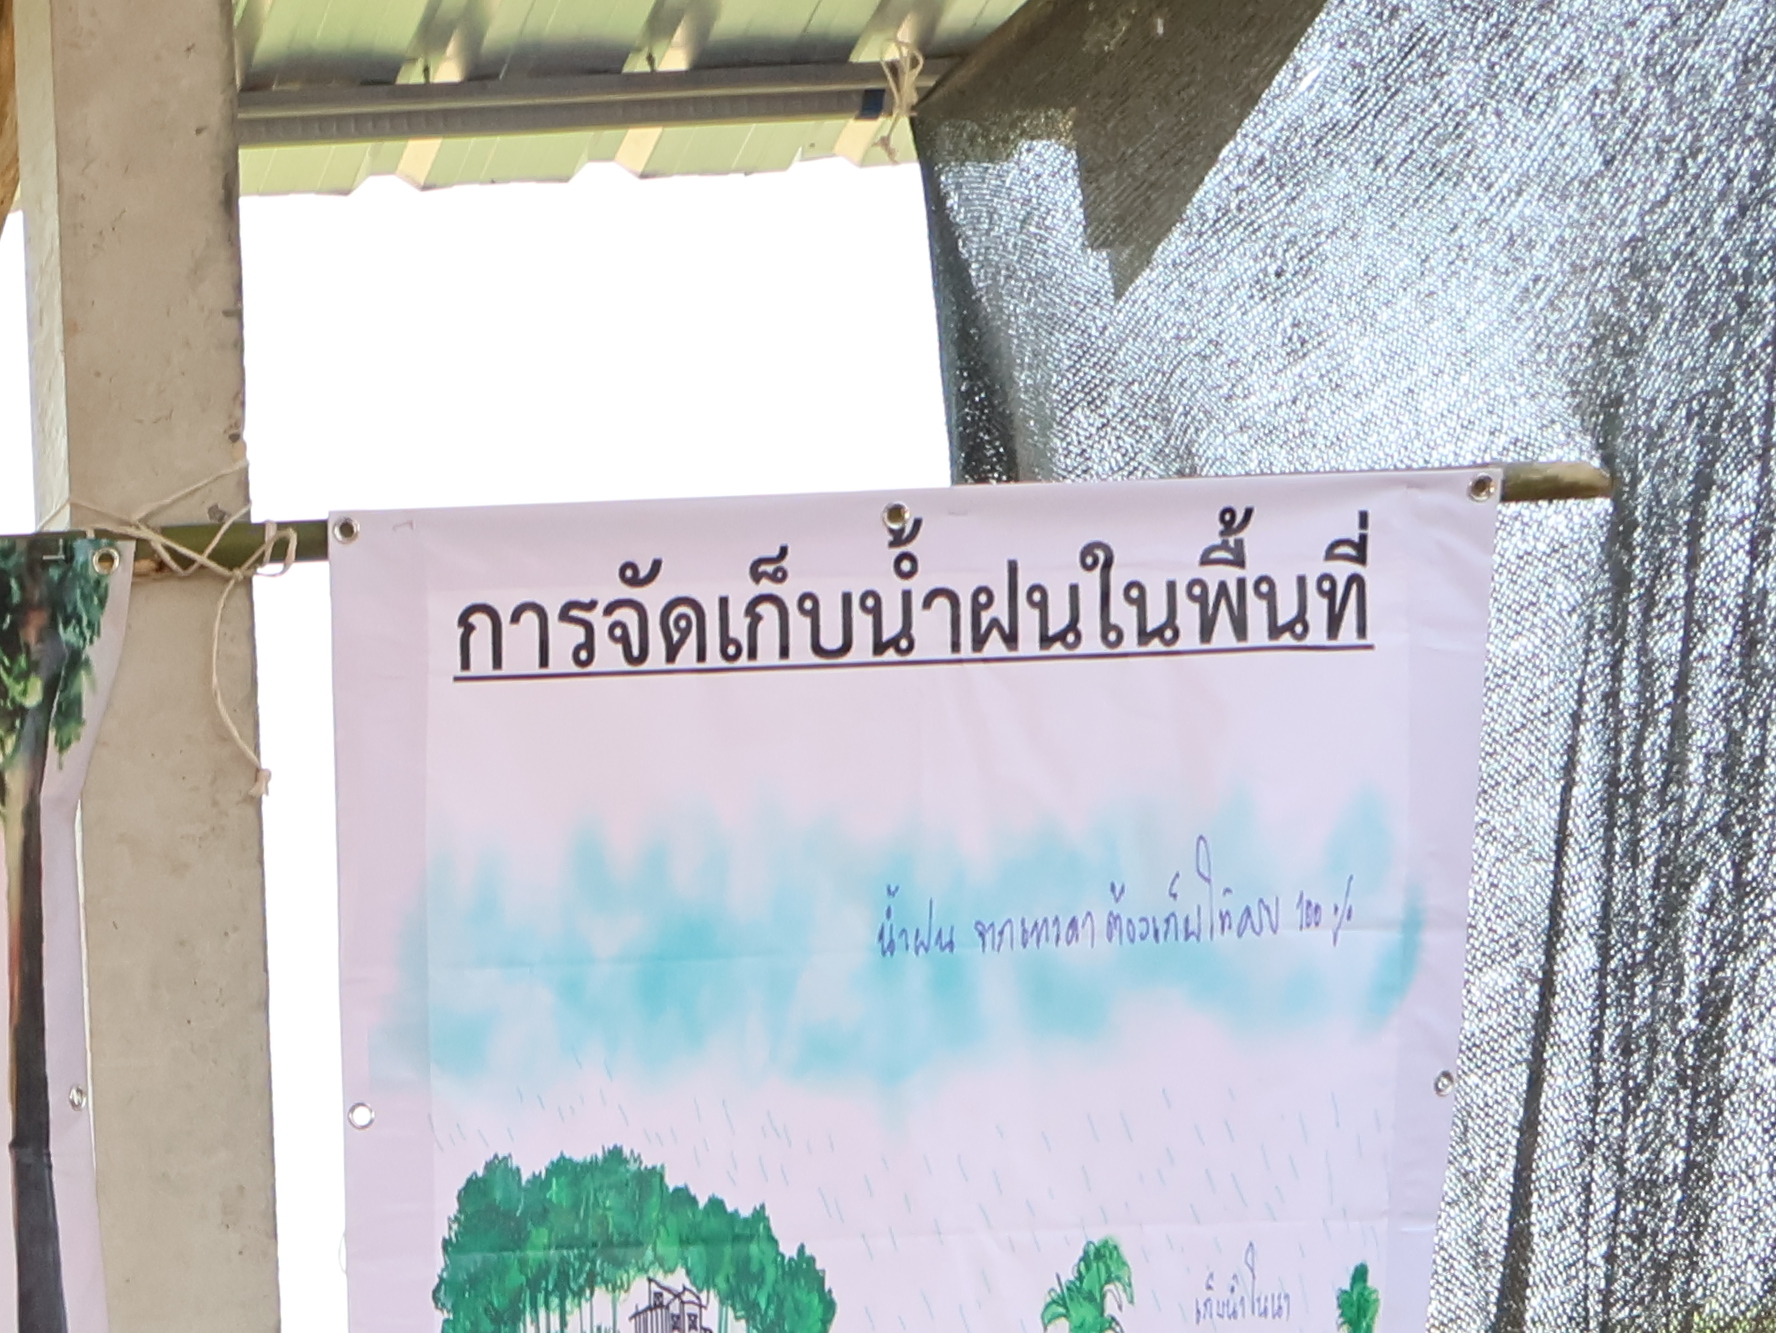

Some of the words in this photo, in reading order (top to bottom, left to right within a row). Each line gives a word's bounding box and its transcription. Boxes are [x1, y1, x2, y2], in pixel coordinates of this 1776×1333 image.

[457, 506, 1371, 674] การจัดเก็บน้ำฝนในพื้นที่
